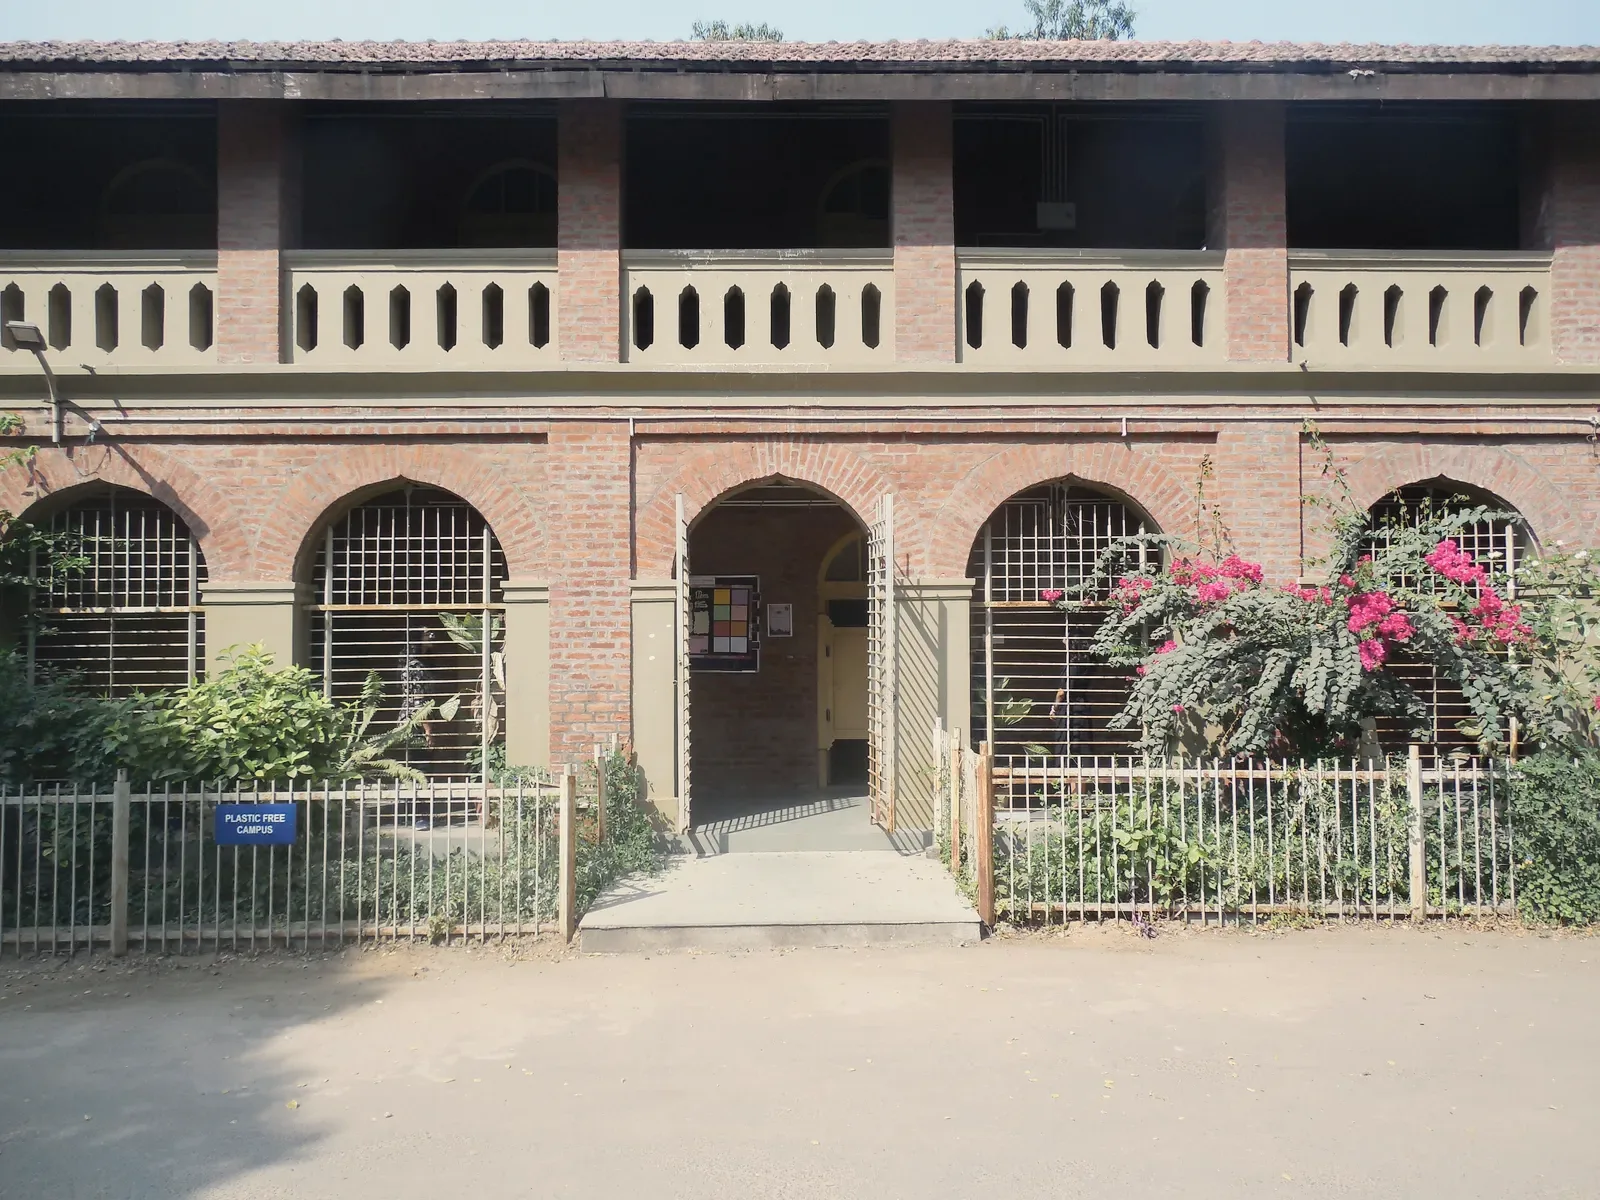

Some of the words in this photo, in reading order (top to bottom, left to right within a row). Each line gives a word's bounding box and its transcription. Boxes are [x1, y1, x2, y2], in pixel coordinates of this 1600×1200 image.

[225, 814, 261, 823] PLASTIC
[262, 813, 286, 823] FREE
[236, 825, 274, 834] CAMPUS
